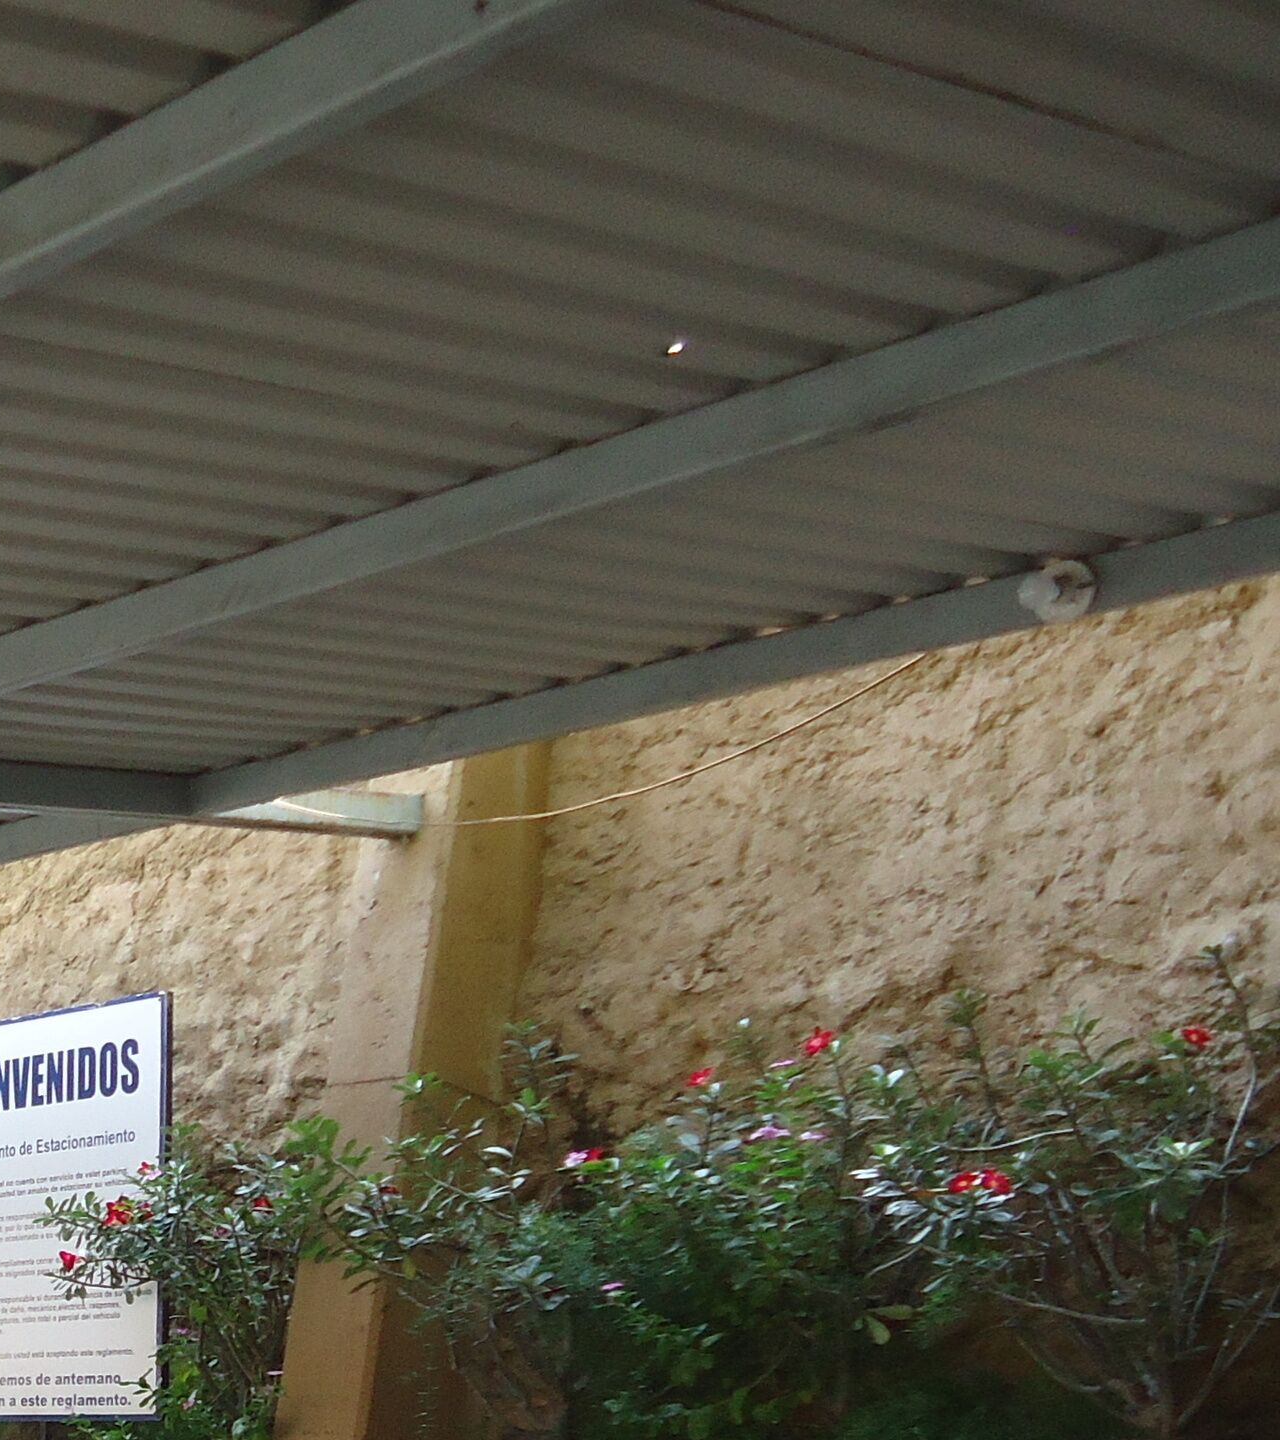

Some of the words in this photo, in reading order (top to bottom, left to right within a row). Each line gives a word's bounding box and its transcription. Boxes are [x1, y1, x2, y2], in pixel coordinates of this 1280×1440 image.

[19, 1140, 33, 1157] de
[36, 1129, 135, 1155] Estacionamiento
[50, 1173, 73, 1182] servicio
[76, 1171, 83, 1179] de
[36, 1373, 51, 1386] de
[55, 1373, 121, 1385] antemano
[9, 1397, 16, 1406] a
[20, 1395, 48, 1407] este
[51, 1394, 131, 1410] reglamento.
